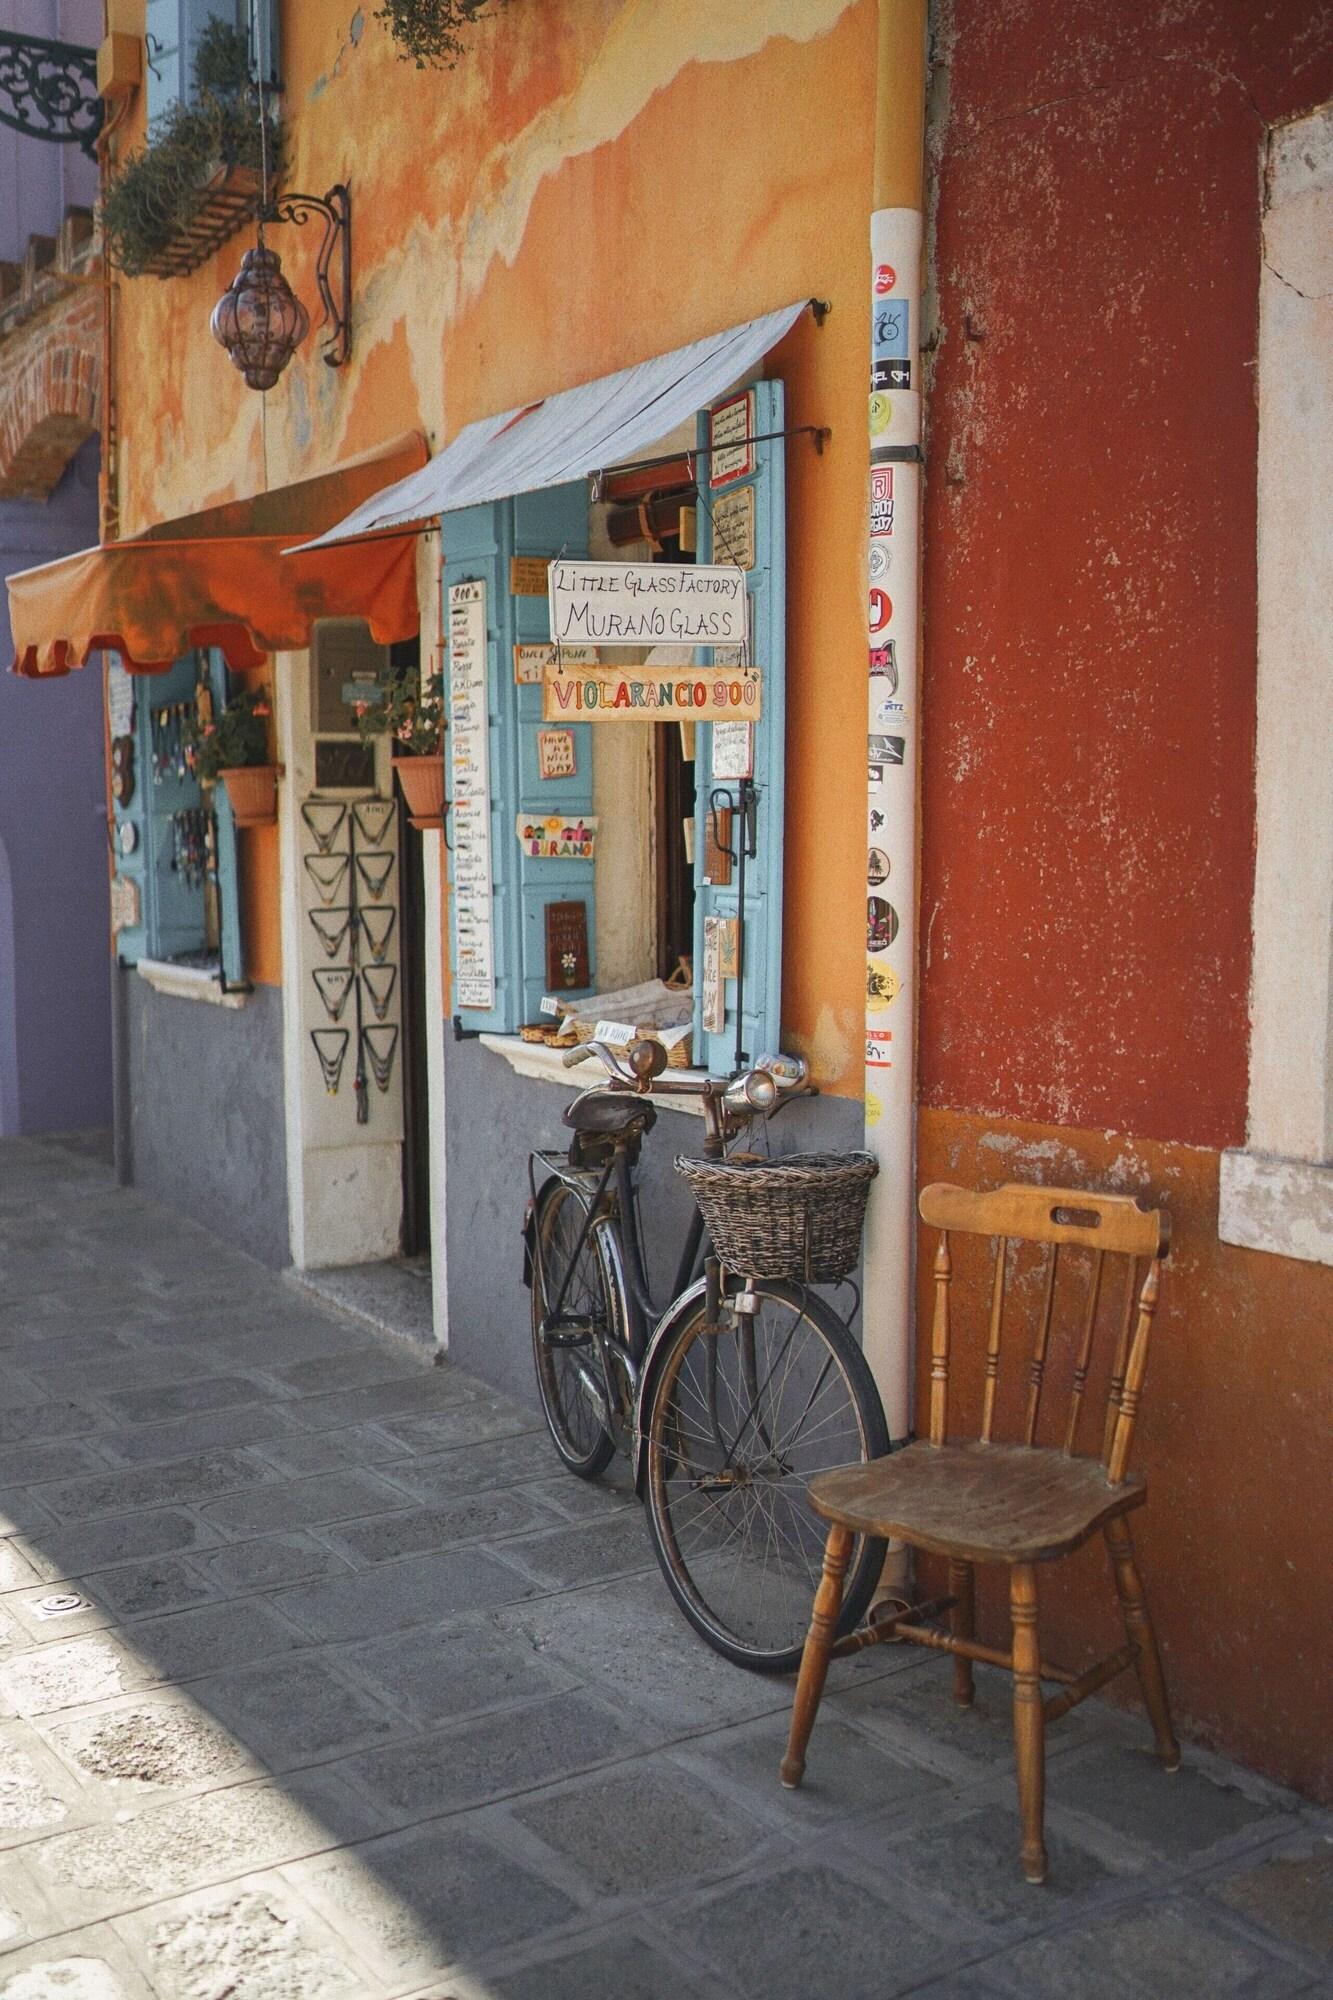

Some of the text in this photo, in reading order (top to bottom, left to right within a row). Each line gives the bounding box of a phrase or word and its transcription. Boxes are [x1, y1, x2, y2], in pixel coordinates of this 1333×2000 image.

[624, 571, 677, 597] GLASS
[679, 571, 741, 600] FACTORY
[562, 601, 733, 639] MURANO GLASS
[553, 680, 707, 711] VIOLARANCIO
[531, 840, 592, 858] BURANO
